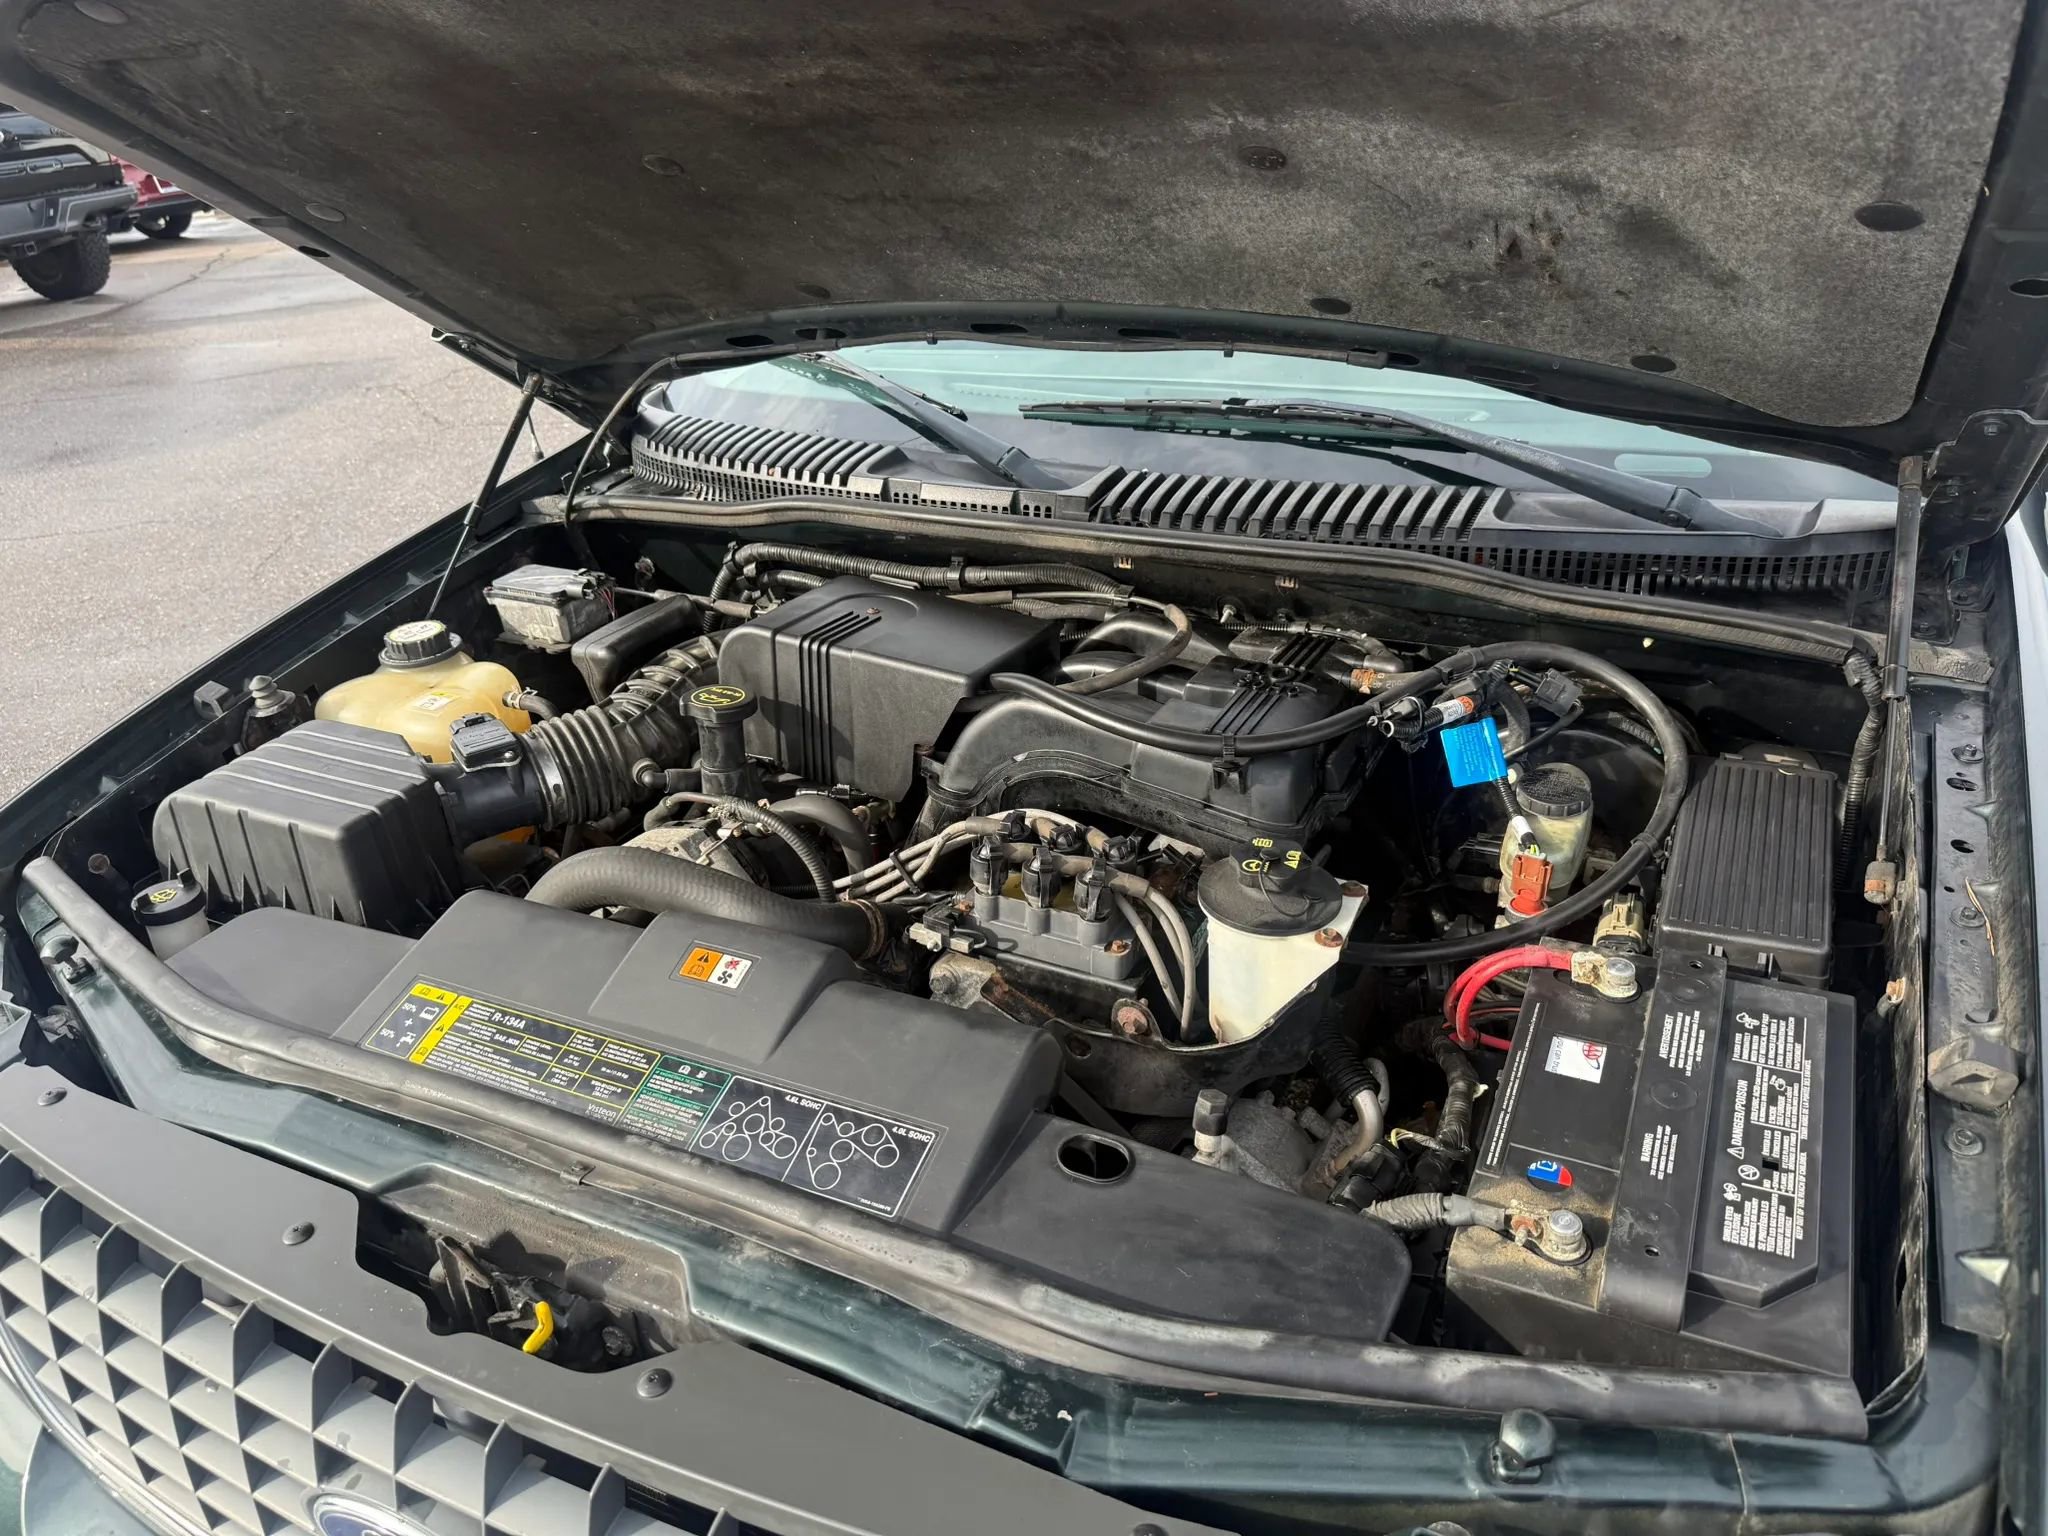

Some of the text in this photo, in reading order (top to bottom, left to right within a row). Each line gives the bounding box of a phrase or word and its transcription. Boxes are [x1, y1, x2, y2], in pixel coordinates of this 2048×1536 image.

[401, 1002, 418, 1012] 50%
[490, 1012, 528, 1029] R-134A
[379, 1028, 397, 1038] 50%
[1659, 1014, 1674, 1059] AVERTISSEMENT
[784, 1094, 822, 1110] 4.6L SOHC
[587, 1104, 617, 1118] Visteon
[1732, 1079, 1748, 1146] DANGER/POISON
[891, 1125, 931, 1143] 4.0L SOHC
[1641, 1133, 1654, 1162] WARNING
[1723, 1206, 1733, 1241] SHIELD EYES
